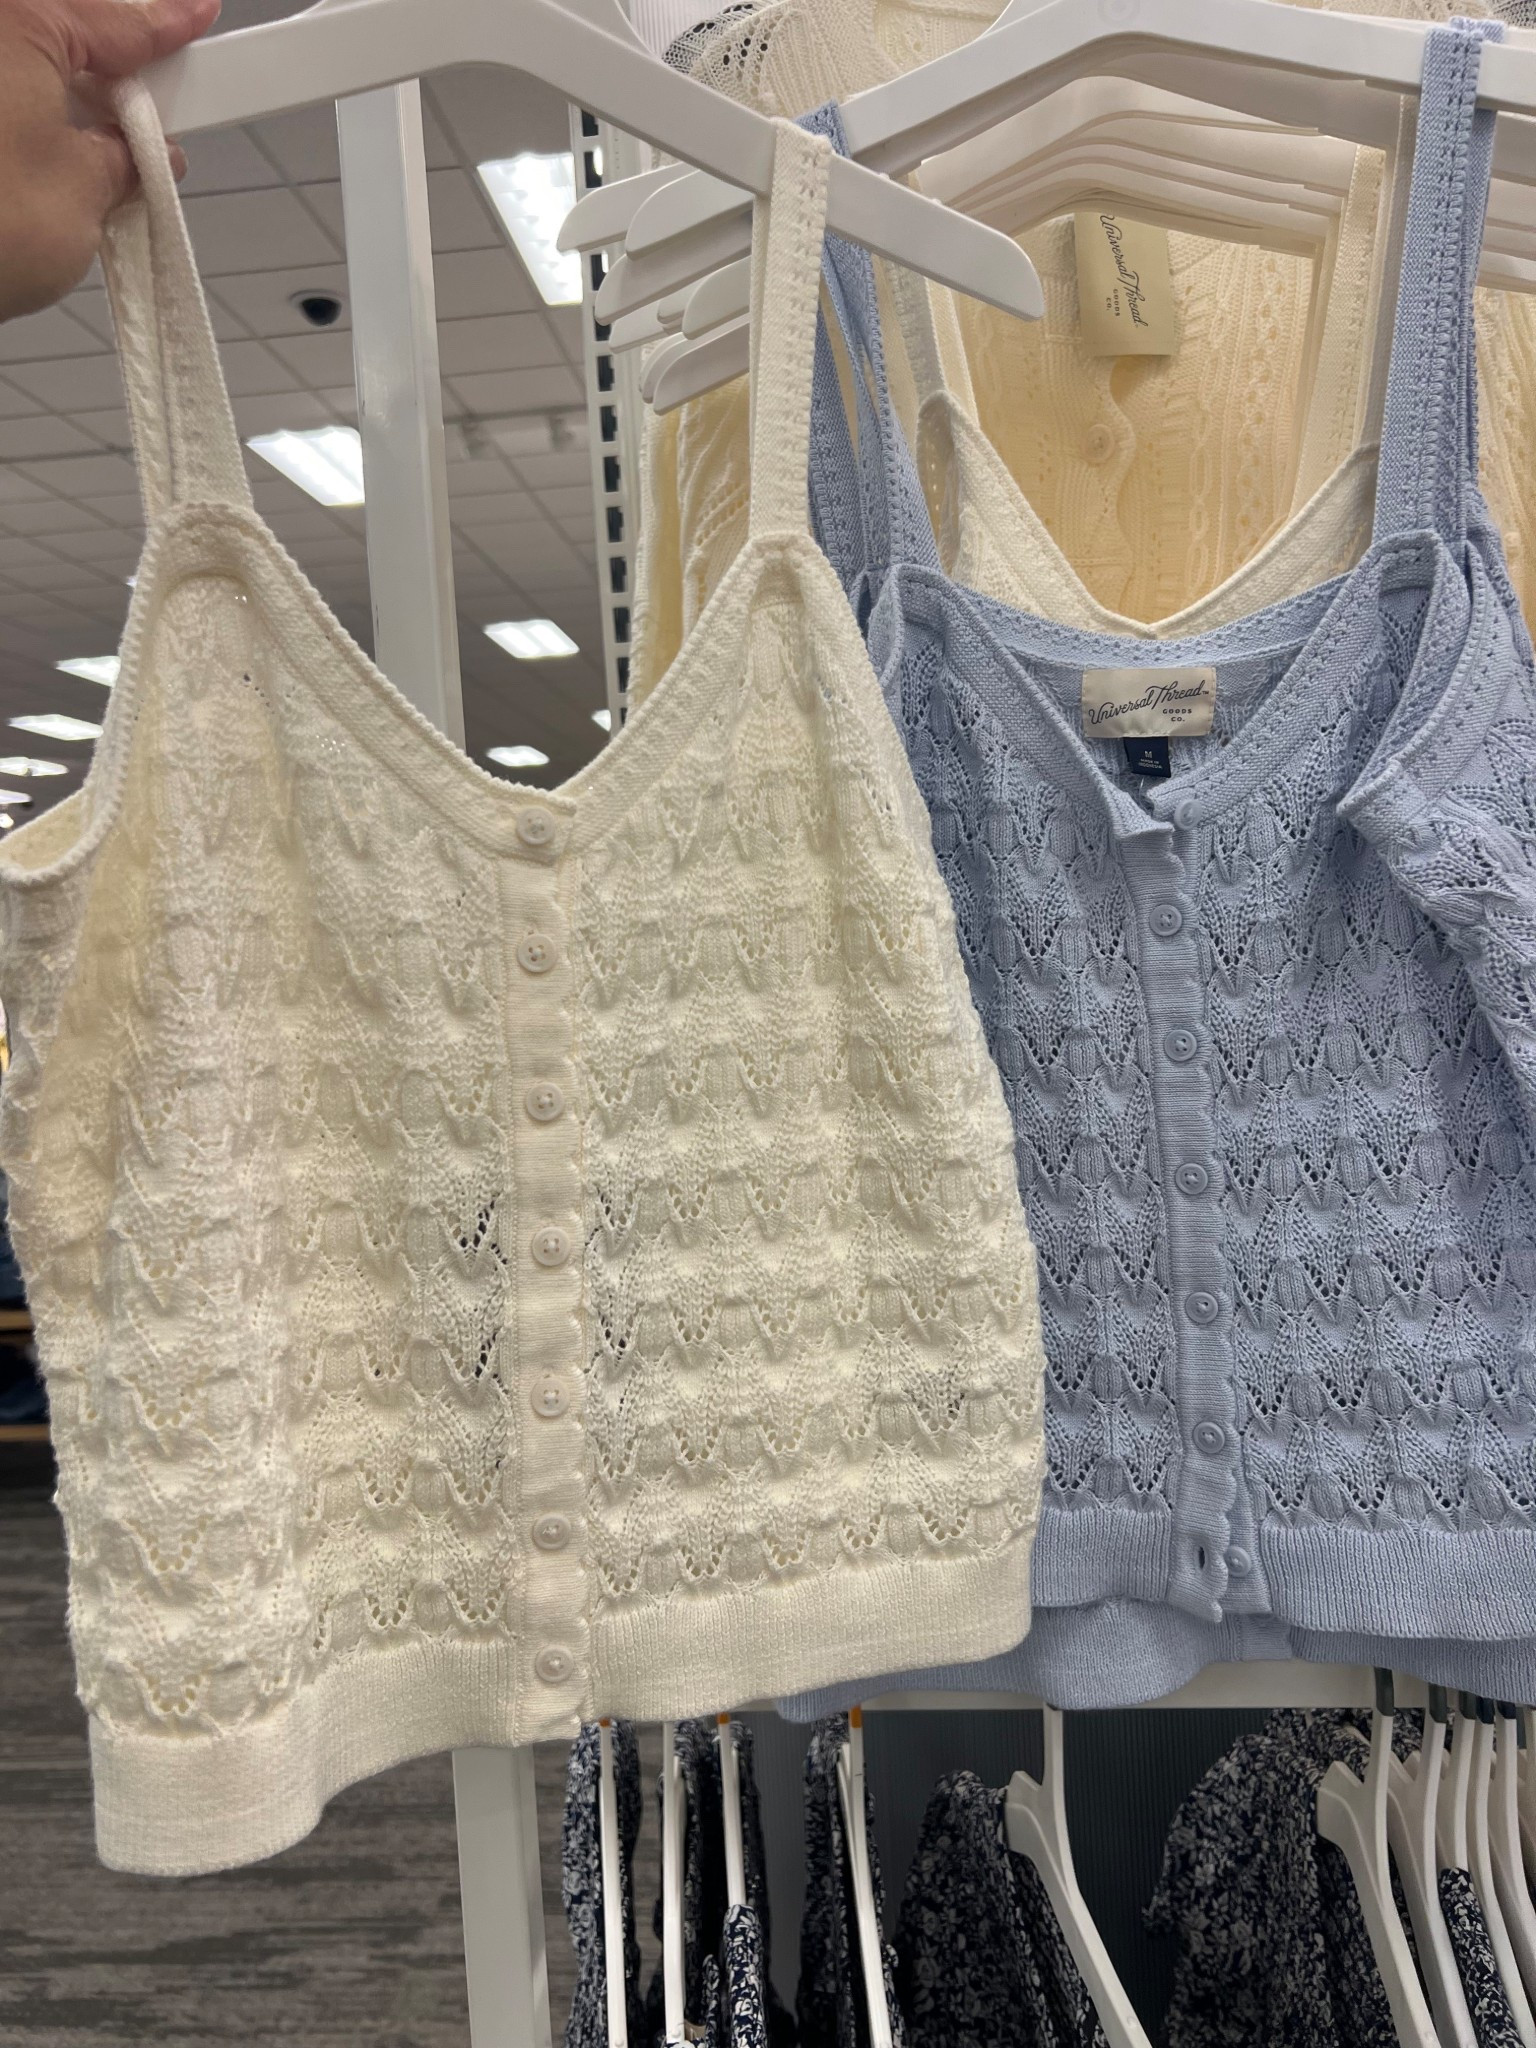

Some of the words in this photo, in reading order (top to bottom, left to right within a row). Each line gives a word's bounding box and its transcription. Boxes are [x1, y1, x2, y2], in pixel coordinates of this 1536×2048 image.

[1100, 215, 1136, 280] Universal
[1113, 288, 1121, 317] GOODS
[1088, 689, 1155, 725] Universal
[1144, 750, 1153, 759] M
